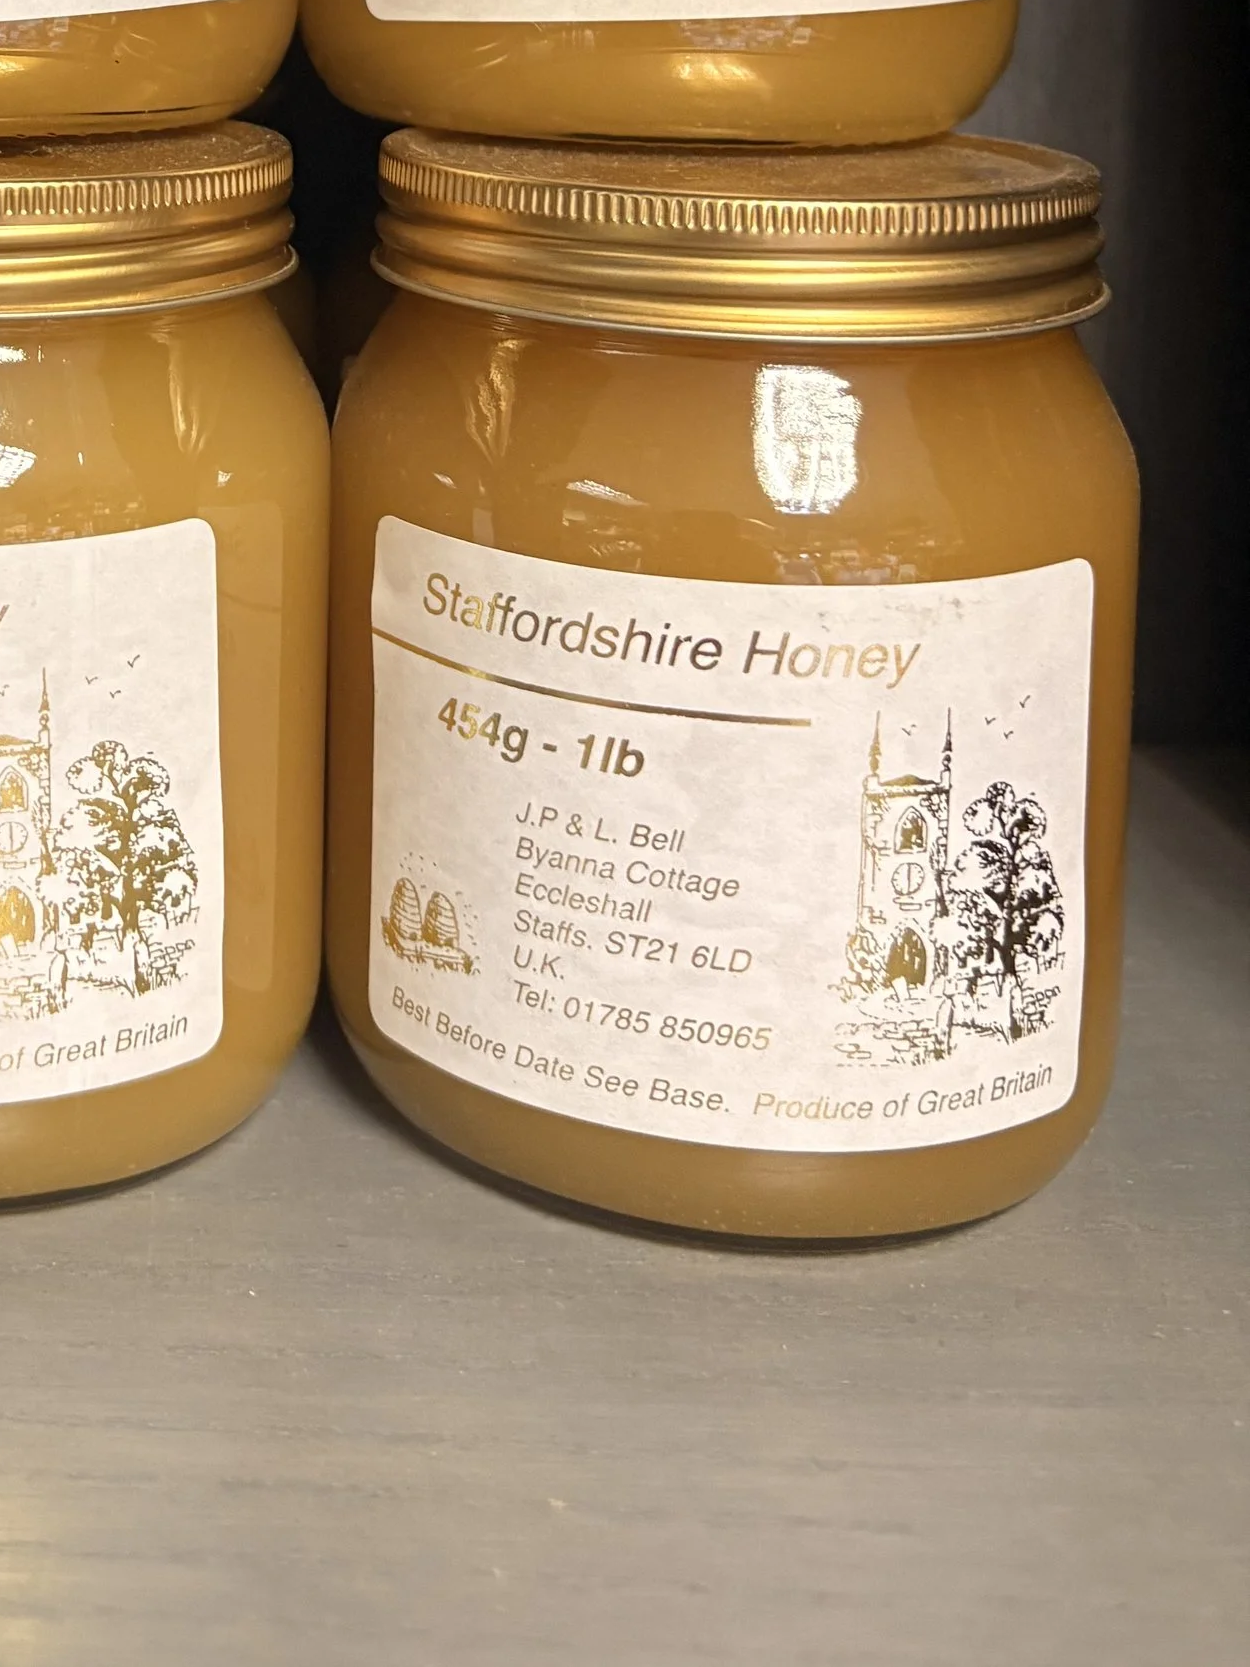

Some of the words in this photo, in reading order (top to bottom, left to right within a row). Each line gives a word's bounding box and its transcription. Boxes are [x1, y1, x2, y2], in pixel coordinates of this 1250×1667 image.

[423, 573, 723, 675] Staffordshire
[743, 631, 921, 688] Honey
[438, 697, 529, 762] 454g
[579, 733, 645, 779] 1lb
[516, 802, 558, 831] J.P
[595, 816, 617, 844] L.
[630, 823, 684, 854] Bell
[515, 838, 615, 882] Byanna
[625, 860, 740, 899] Cottage
[515, 874, 651, 922] Eccleshall
[513, 947, 564, 980] U.K.
[514, 911, 592, 951] Staffs.
[605, 931, 678, 965] ST21
[690, 945, 751, 974] 6LD
[34, 1036, 107, 1069] Great
[115, 1015, 188, 1052] Britain
[513, 982, 554, 1014] Tel:
[563, 996, 650, 1034] 01785
[659, 1016, 772, 1050] 850965
[391, 986, 431, 1027] Best
[435, 1011, 506, 1060] Before
[514, 1045, 574, 1082] Date
[583, 1064, 639, 1097] See
[650, 1080, 730, 1114] Base.
[752, 1092, 872, 1121] Produce
[883, 1090, 909, 1118] of
[918, 1078, 984, 1117] Great
[990, 1063, 1053, 1103] Britain
